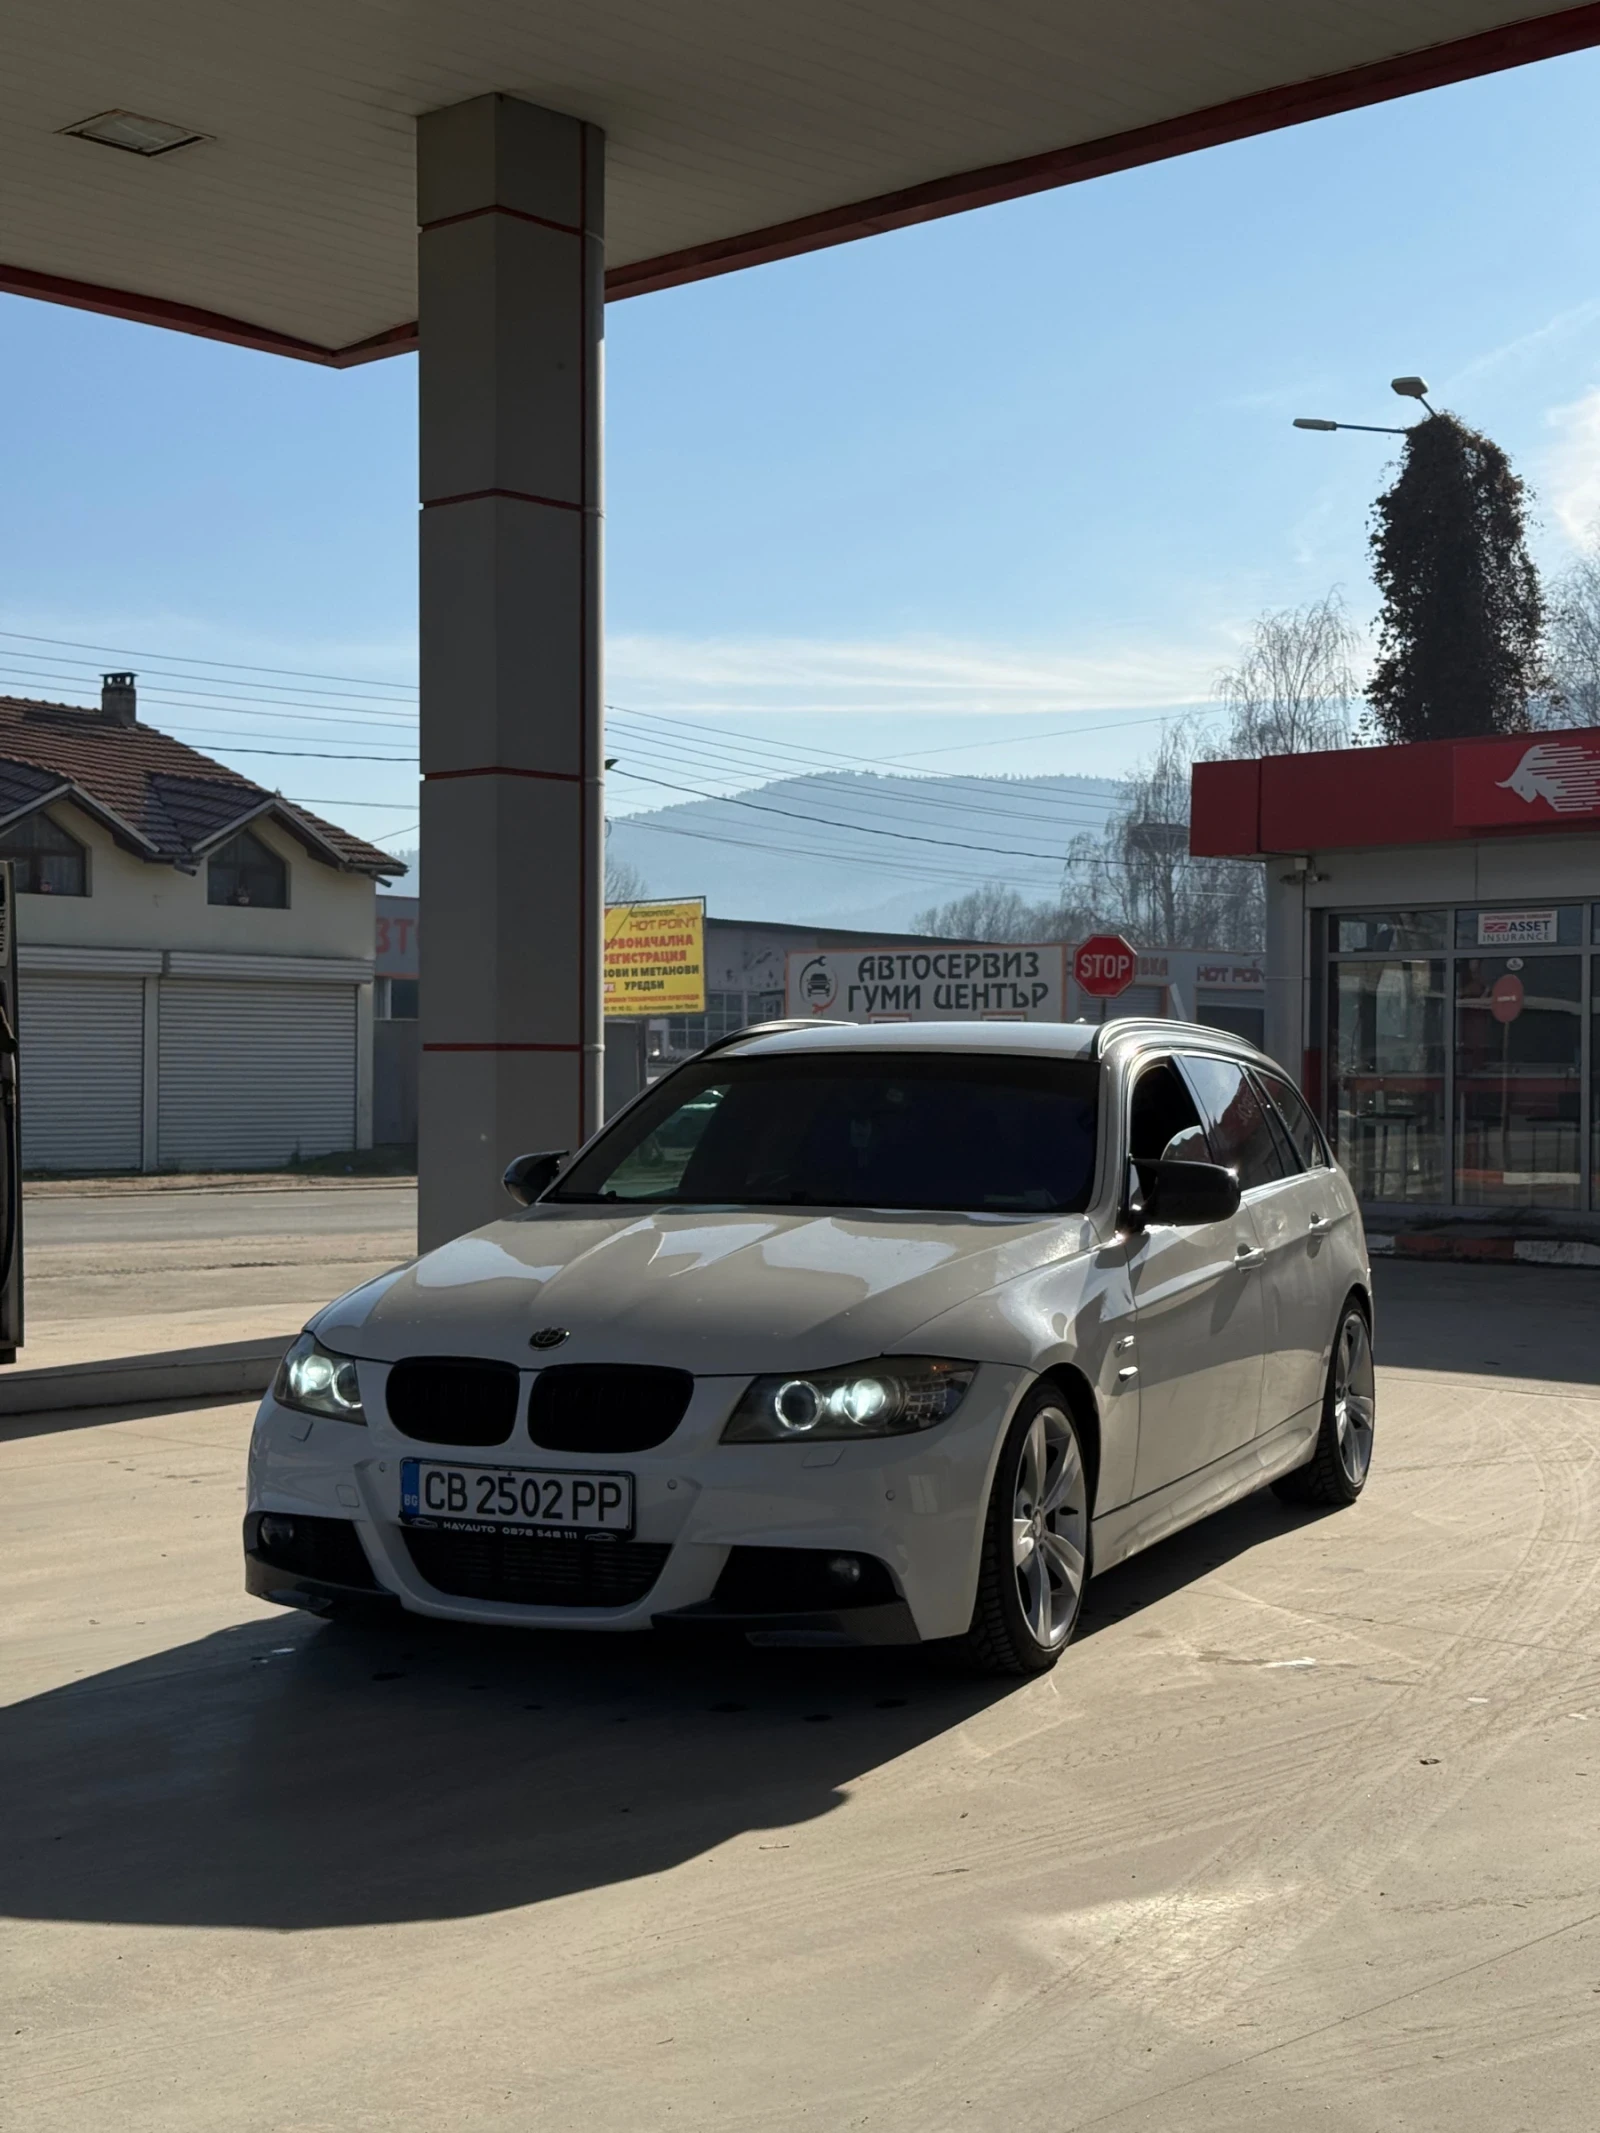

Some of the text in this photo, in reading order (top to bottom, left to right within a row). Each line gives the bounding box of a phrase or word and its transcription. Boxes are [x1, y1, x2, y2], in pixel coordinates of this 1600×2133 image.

[629, 916, 698, 931] HOT POINT
[1509, 921, 1551, 931] ASSET
[1483, 932, 1549, 942] INSURANCE
[631, 967, 639, 977] И
[640, 965, 699, 977] МЕТАНОВИ
[857, 951, 1040, 983] АВТОСЕРВИЗ
[1080, 953, 1130, 979] STOP
[1197, 965, 1229, 982] HOT
[624, 980, 665, 991] УРЕДБИ
[848, 982, 1049, 1012] ГУМИ ЦЕНТЪР
[404, 1494, 418, 1507] BG
[425, 1470, 622, 1521] CB 2502 PP
[443, 1521, 577, 1540] HAYAUTO 0878 548 111
